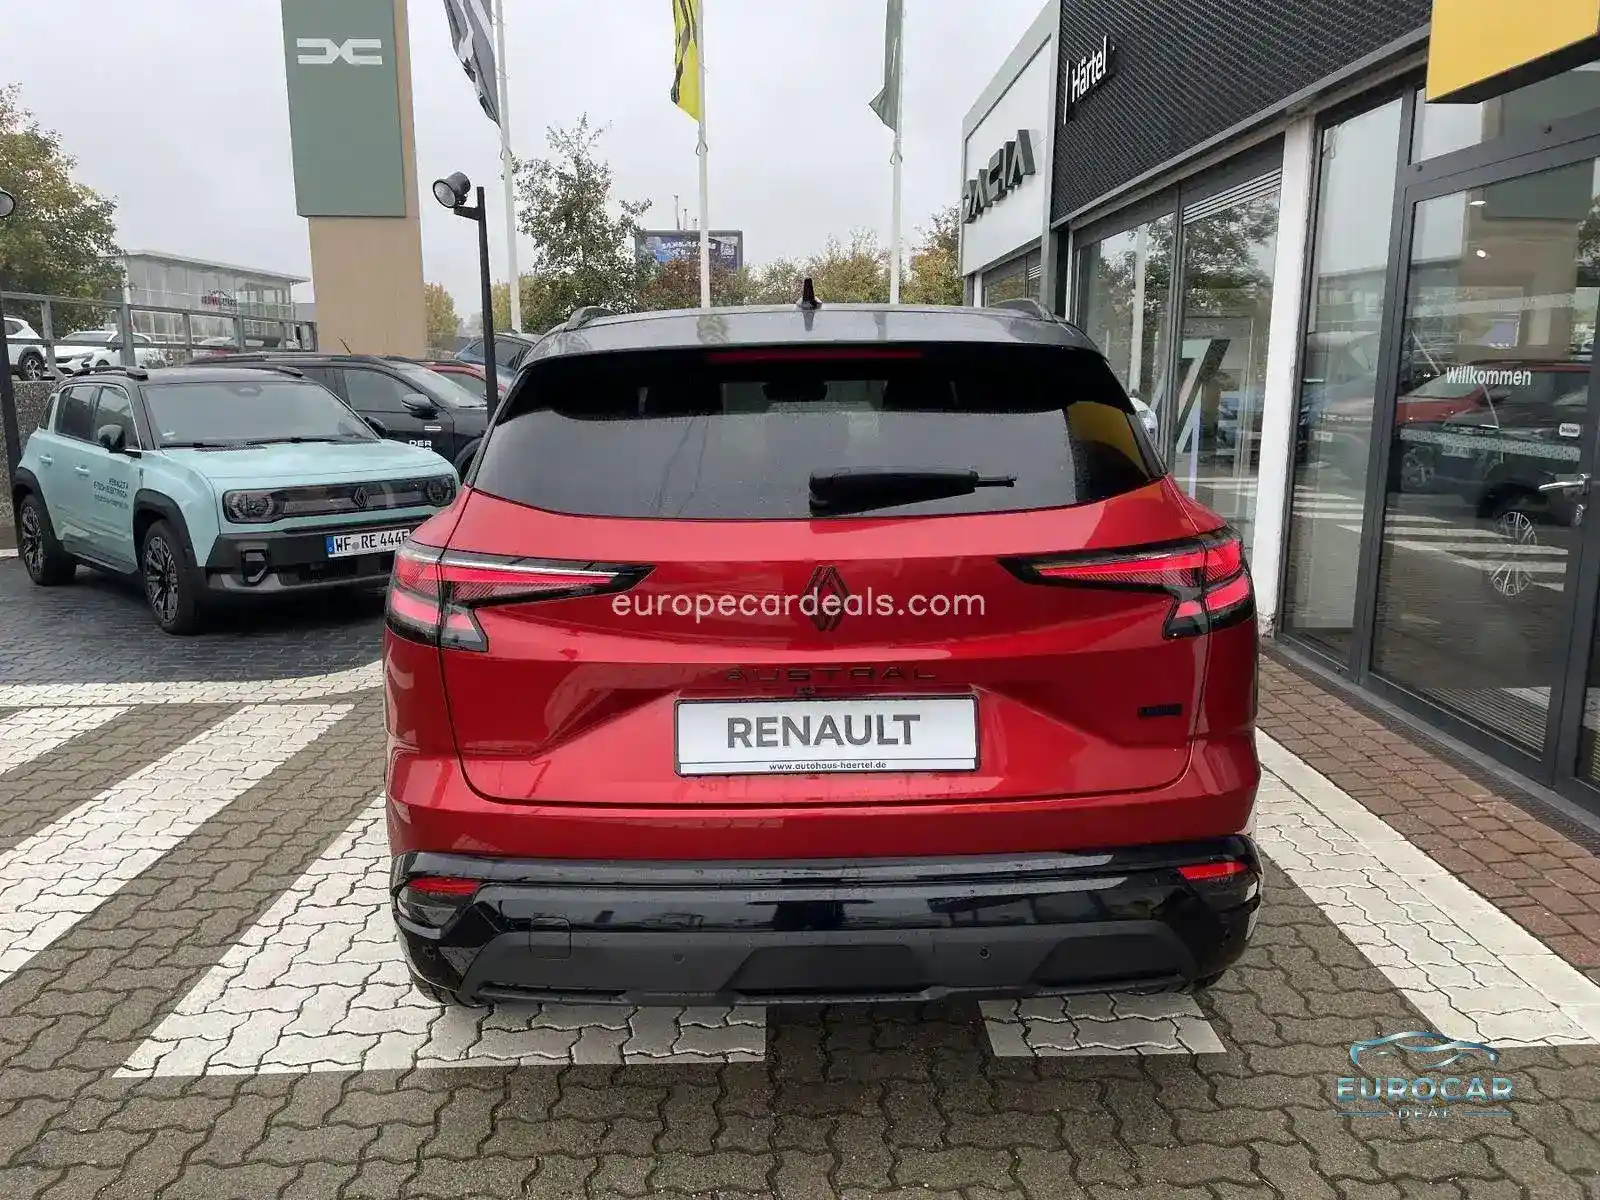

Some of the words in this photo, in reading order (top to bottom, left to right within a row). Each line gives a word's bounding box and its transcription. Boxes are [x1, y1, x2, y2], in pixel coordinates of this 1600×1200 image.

[1071, 35, 1107, 102] Härtel
[1446, 365, 1532, 386] Willkommen
[335, 536, 351, 551] WF
[361, 534, 377, 549] RE
[723, 666, 937, 682] AUSTRAL
[727, 714, 921, 749] RENAULT
[768, 760, 887, 771] www.autohaus-haertel.de
